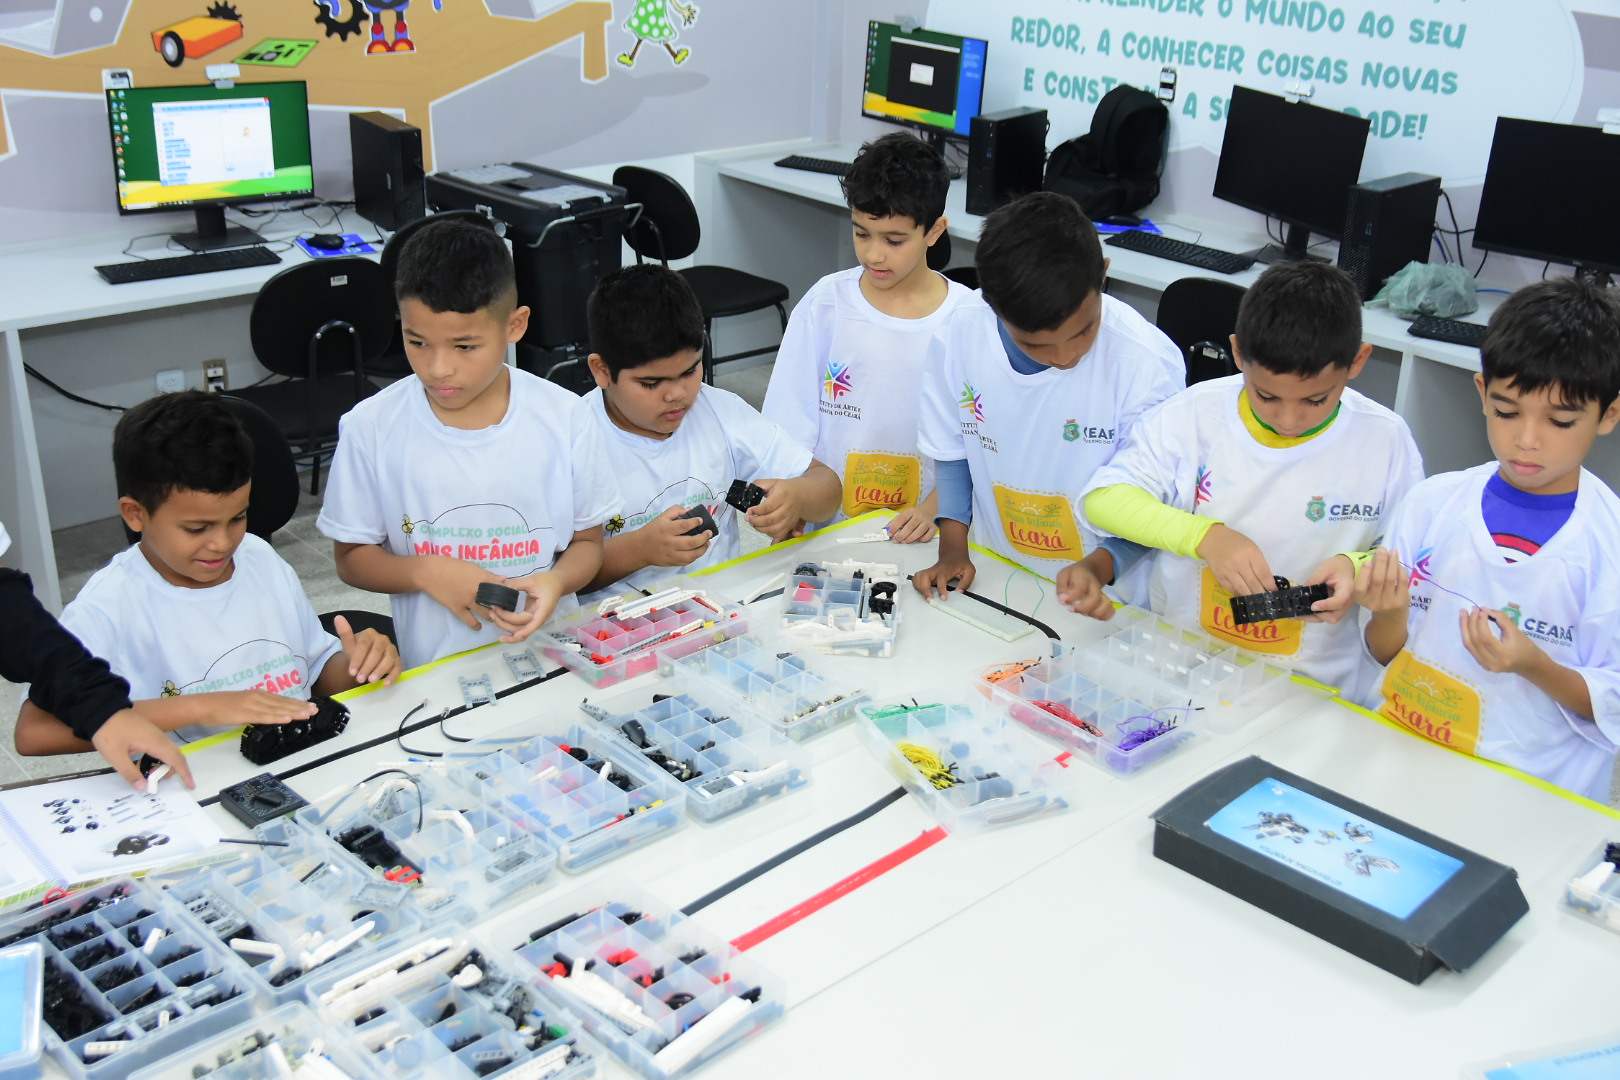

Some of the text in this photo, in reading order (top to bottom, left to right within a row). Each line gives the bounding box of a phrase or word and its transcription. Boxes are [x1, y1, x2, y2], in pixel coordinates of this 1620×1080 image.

[1245, 0, 1345, 32] MUNDO
[1358, 10, 1394, 38] AO
[1408, 18, 1467, 48] SEU
[1010, 16, 1458, 95] REDOR, A CONHECER COISAS NOVAS
[1024, 67, 1035, 91] E
[1182, 92, 1197, 119] A
[1329, 501, 1382, 517] CEARÁ
[458, 538, 540, 561] INFÂNCIA
[1524, 617, 1574, 642] CEARÁ
